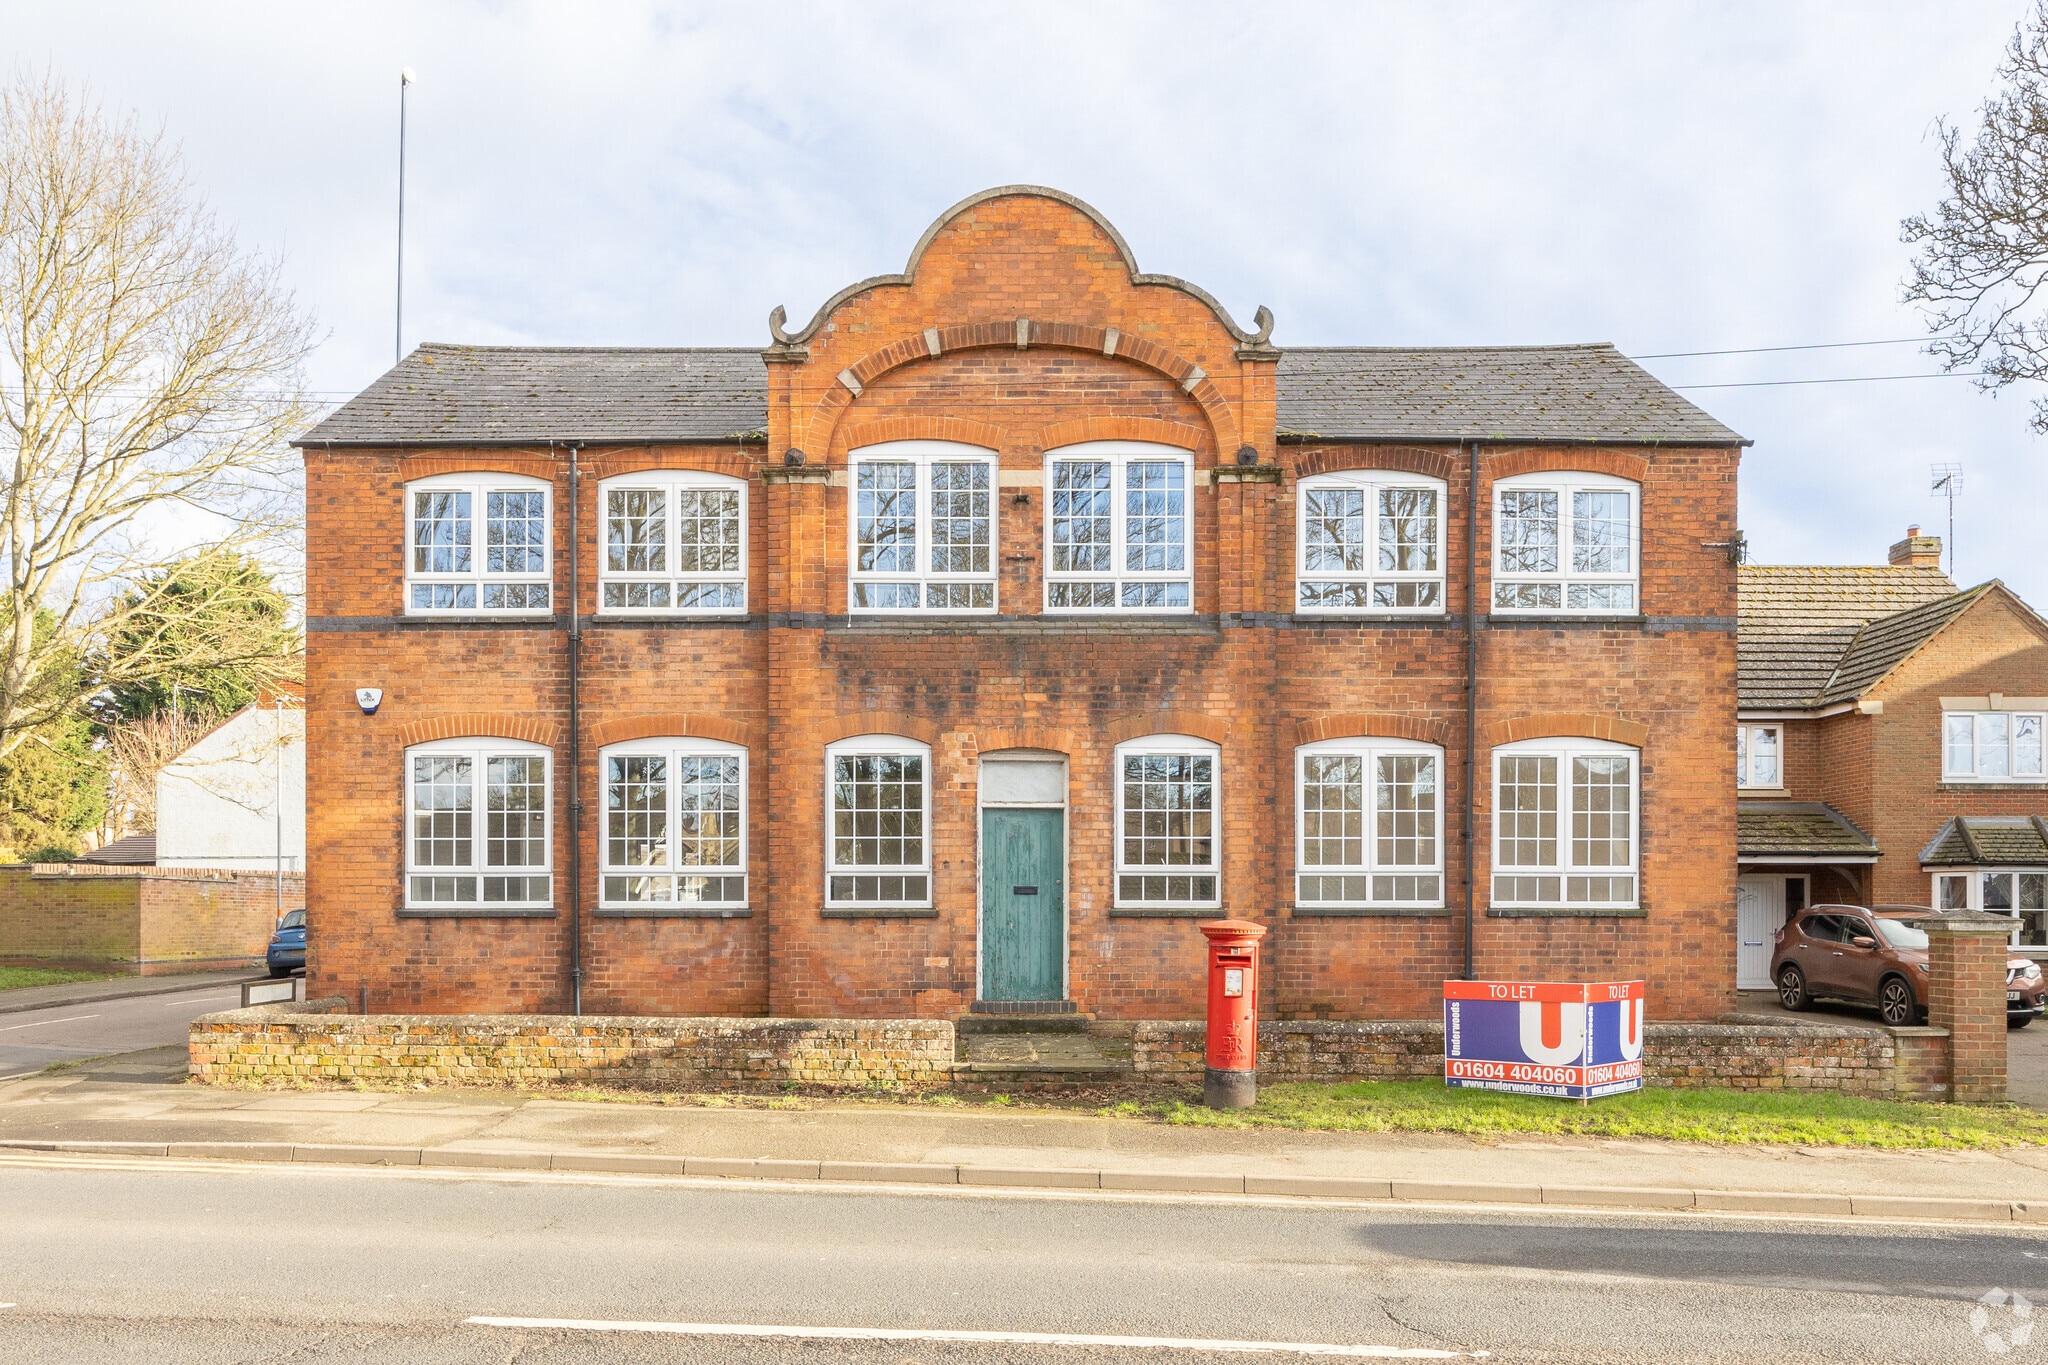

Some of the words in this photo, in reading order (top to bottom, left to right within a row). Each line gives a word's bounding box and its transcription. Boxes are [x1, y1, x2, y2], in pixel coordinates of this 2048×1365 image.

[1488, 984, 1508, 998] TO
[1511, 985, 1536, 999] LET
[1608, 985, 1618, 999] TO
[1618, 985, 1630, 998] LET
[1451, 1001, 1461, 1056] Underwoods
[1453, 1061, 1505, 1079] 01604
[1510, 1066, 1577, 1084] 404060
[1588, 1067, 1613, 1084] 01604
[1614, 1061, 1640, 1080] 404060
[1461, 1079, 1568, 1096] www.underwoods.co.uk
